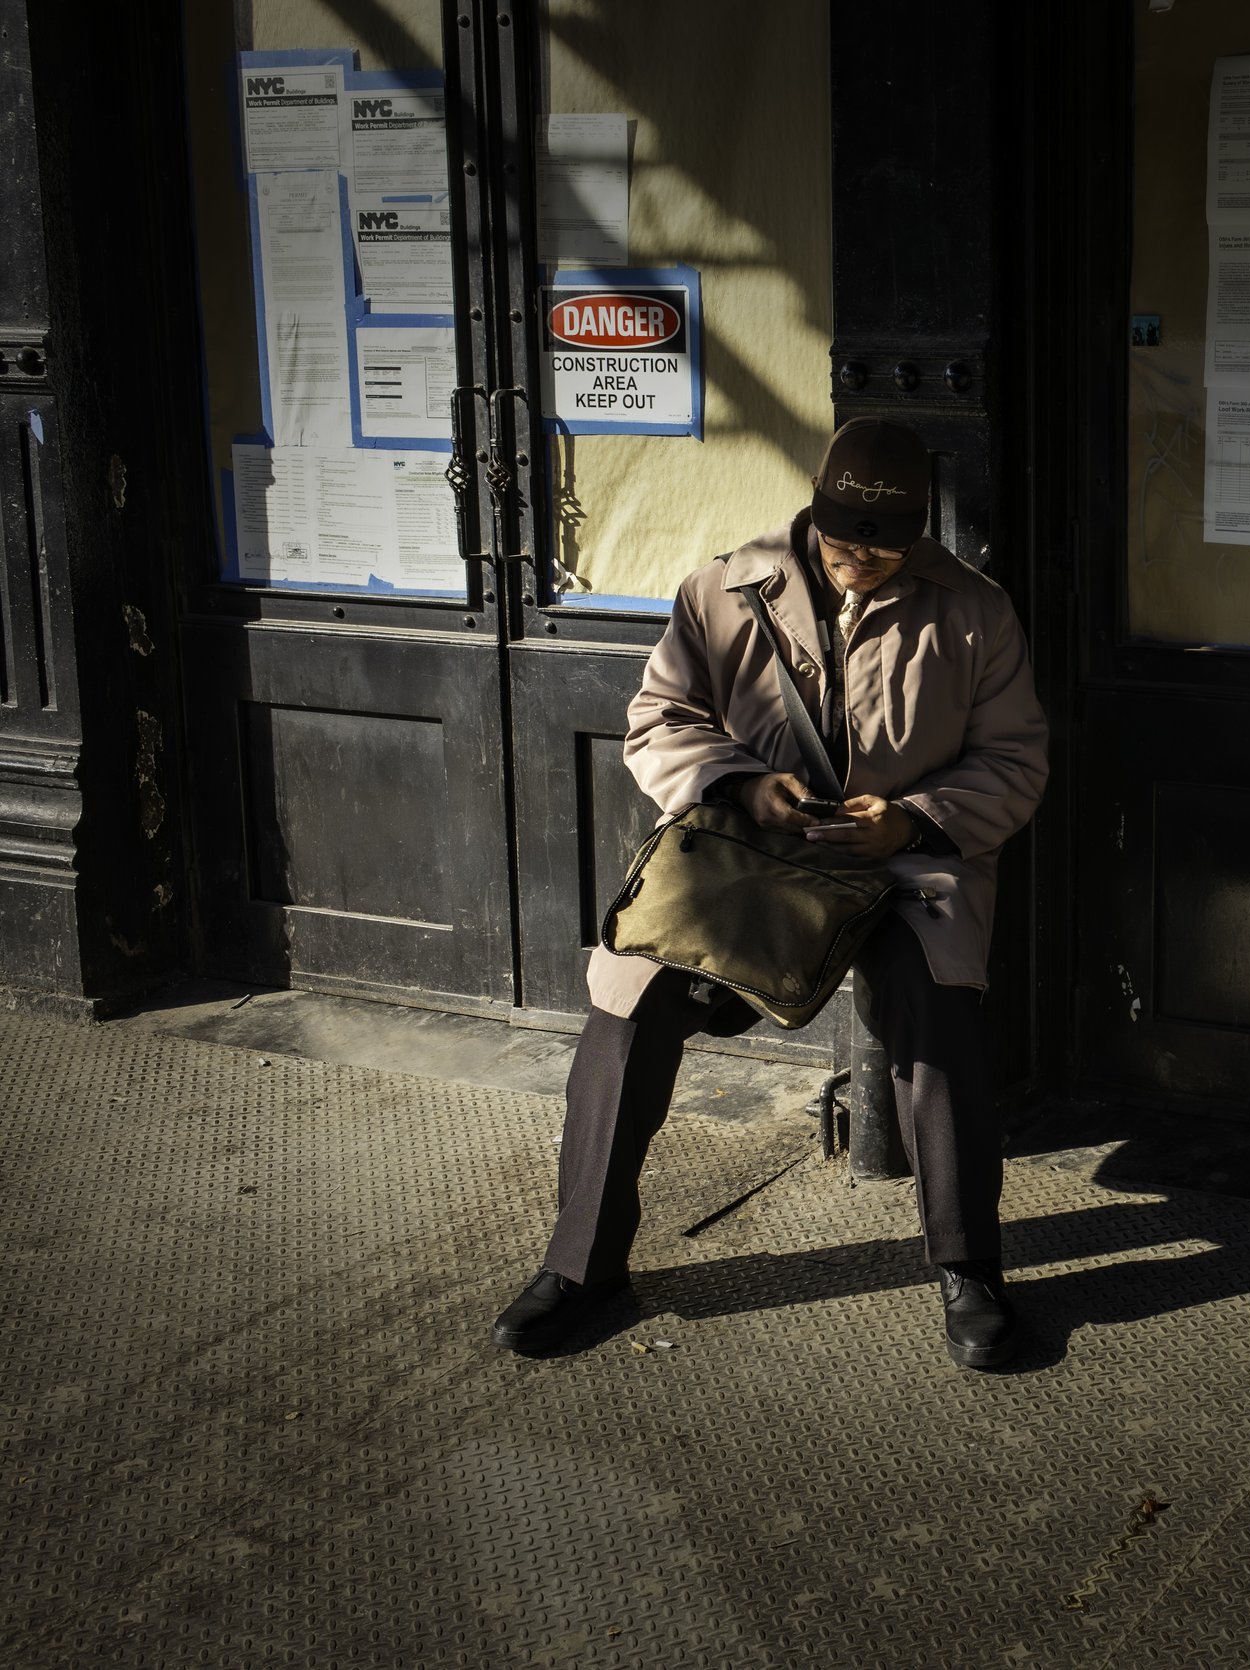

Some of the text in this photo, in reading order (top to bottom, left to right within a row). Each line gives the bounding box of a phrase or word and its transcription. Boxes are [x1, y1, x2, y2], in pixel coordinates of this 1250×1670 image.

[247, 77, 285, 95] NYC
[281, 98, 306, 106] Department
[314, 97, 335, 105] Buildings
[354, 99, 393, 118] NYC
[389, 121, 417, 129] Department
[359, 212, 399, 230] NYC
[563, 305, 665, 337] DANGER
[552, 357, 679, 373] CONSTRUCTION
[592, 375, 638, 391] AREA
[576, 393, 656, 409] KEEP OUT
